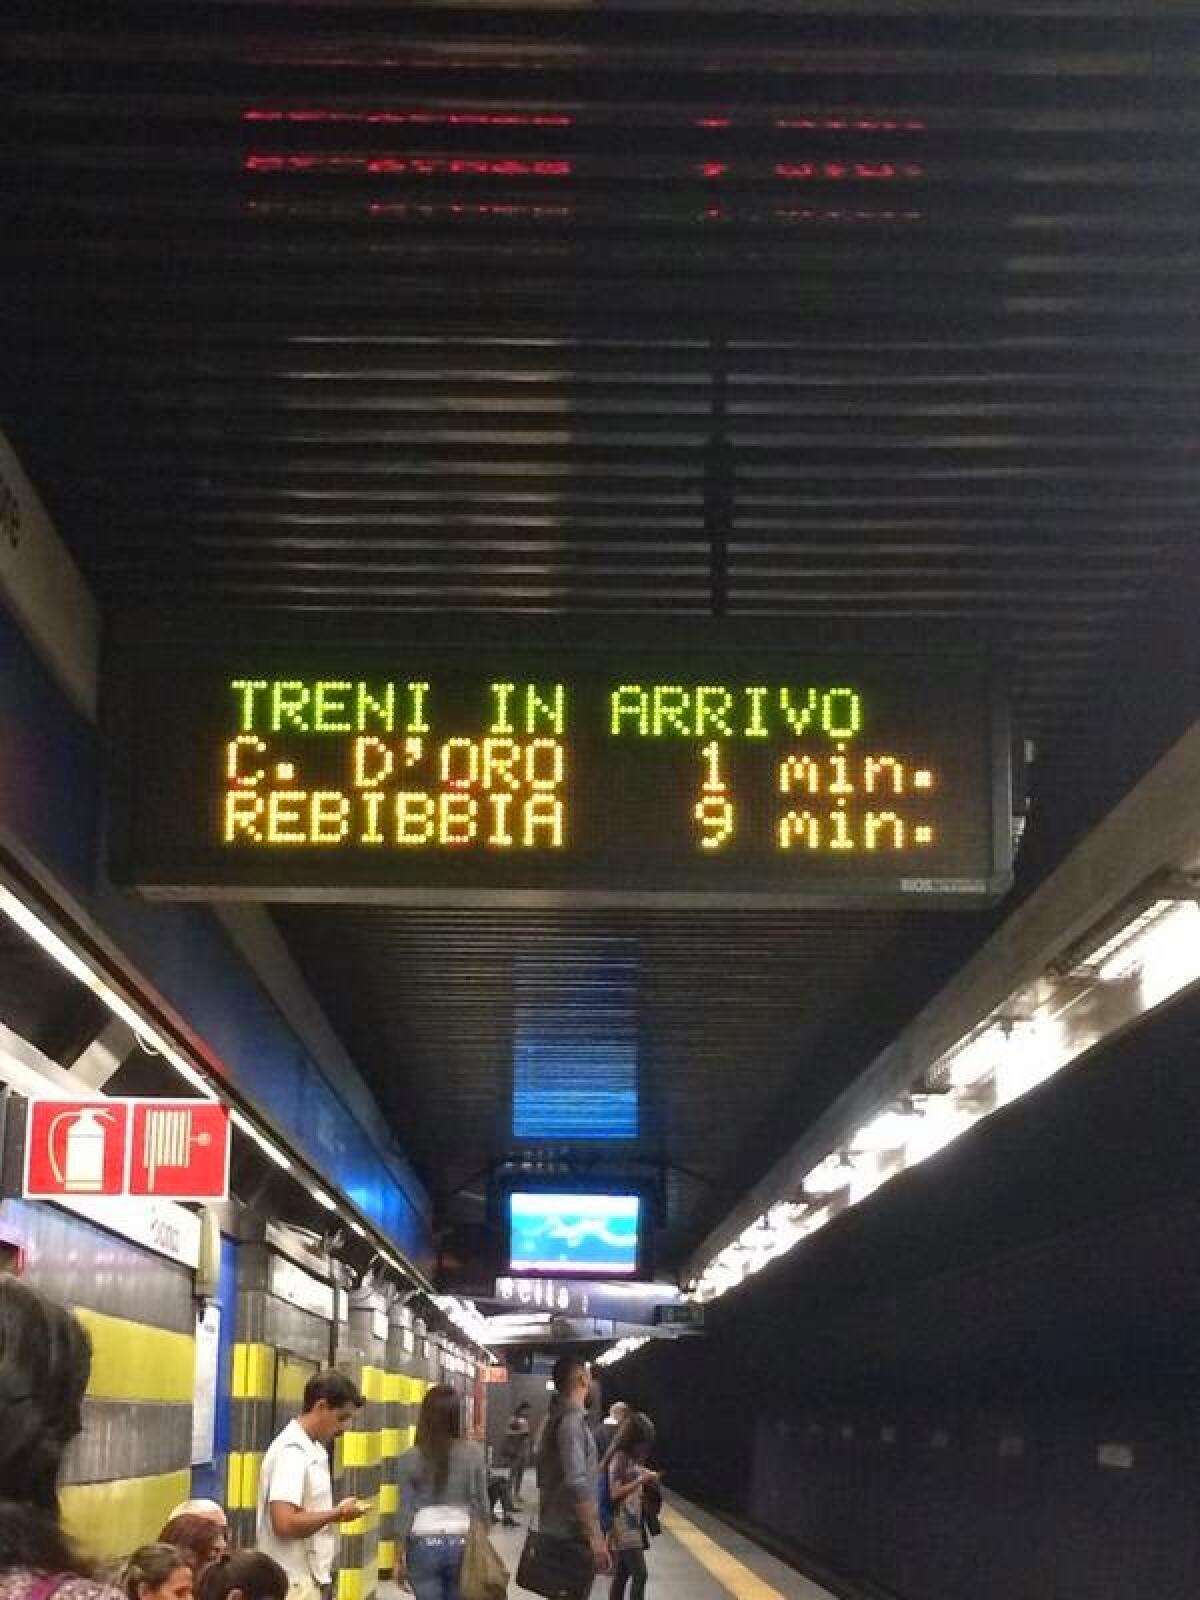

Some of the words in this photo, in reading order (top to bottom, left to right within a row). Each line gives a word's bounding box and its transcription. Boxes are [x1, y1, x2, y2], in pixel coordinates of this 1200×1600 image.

[231, 679, 429, 733] TRENI
[490, 682, 565, 735] IN
[610, 685, 862, 738] ARRIVO
[226, 735, 295, 786] C.
[353, 737, 565, 788] D'ORO
[700, 742, 727, 794] 1
[777, 743, 935, 794] min.
[223, 790, 565, 847] REBIBBIA
[693, 794, 735, 849] 9
[777, 798, 935, 850] min.
